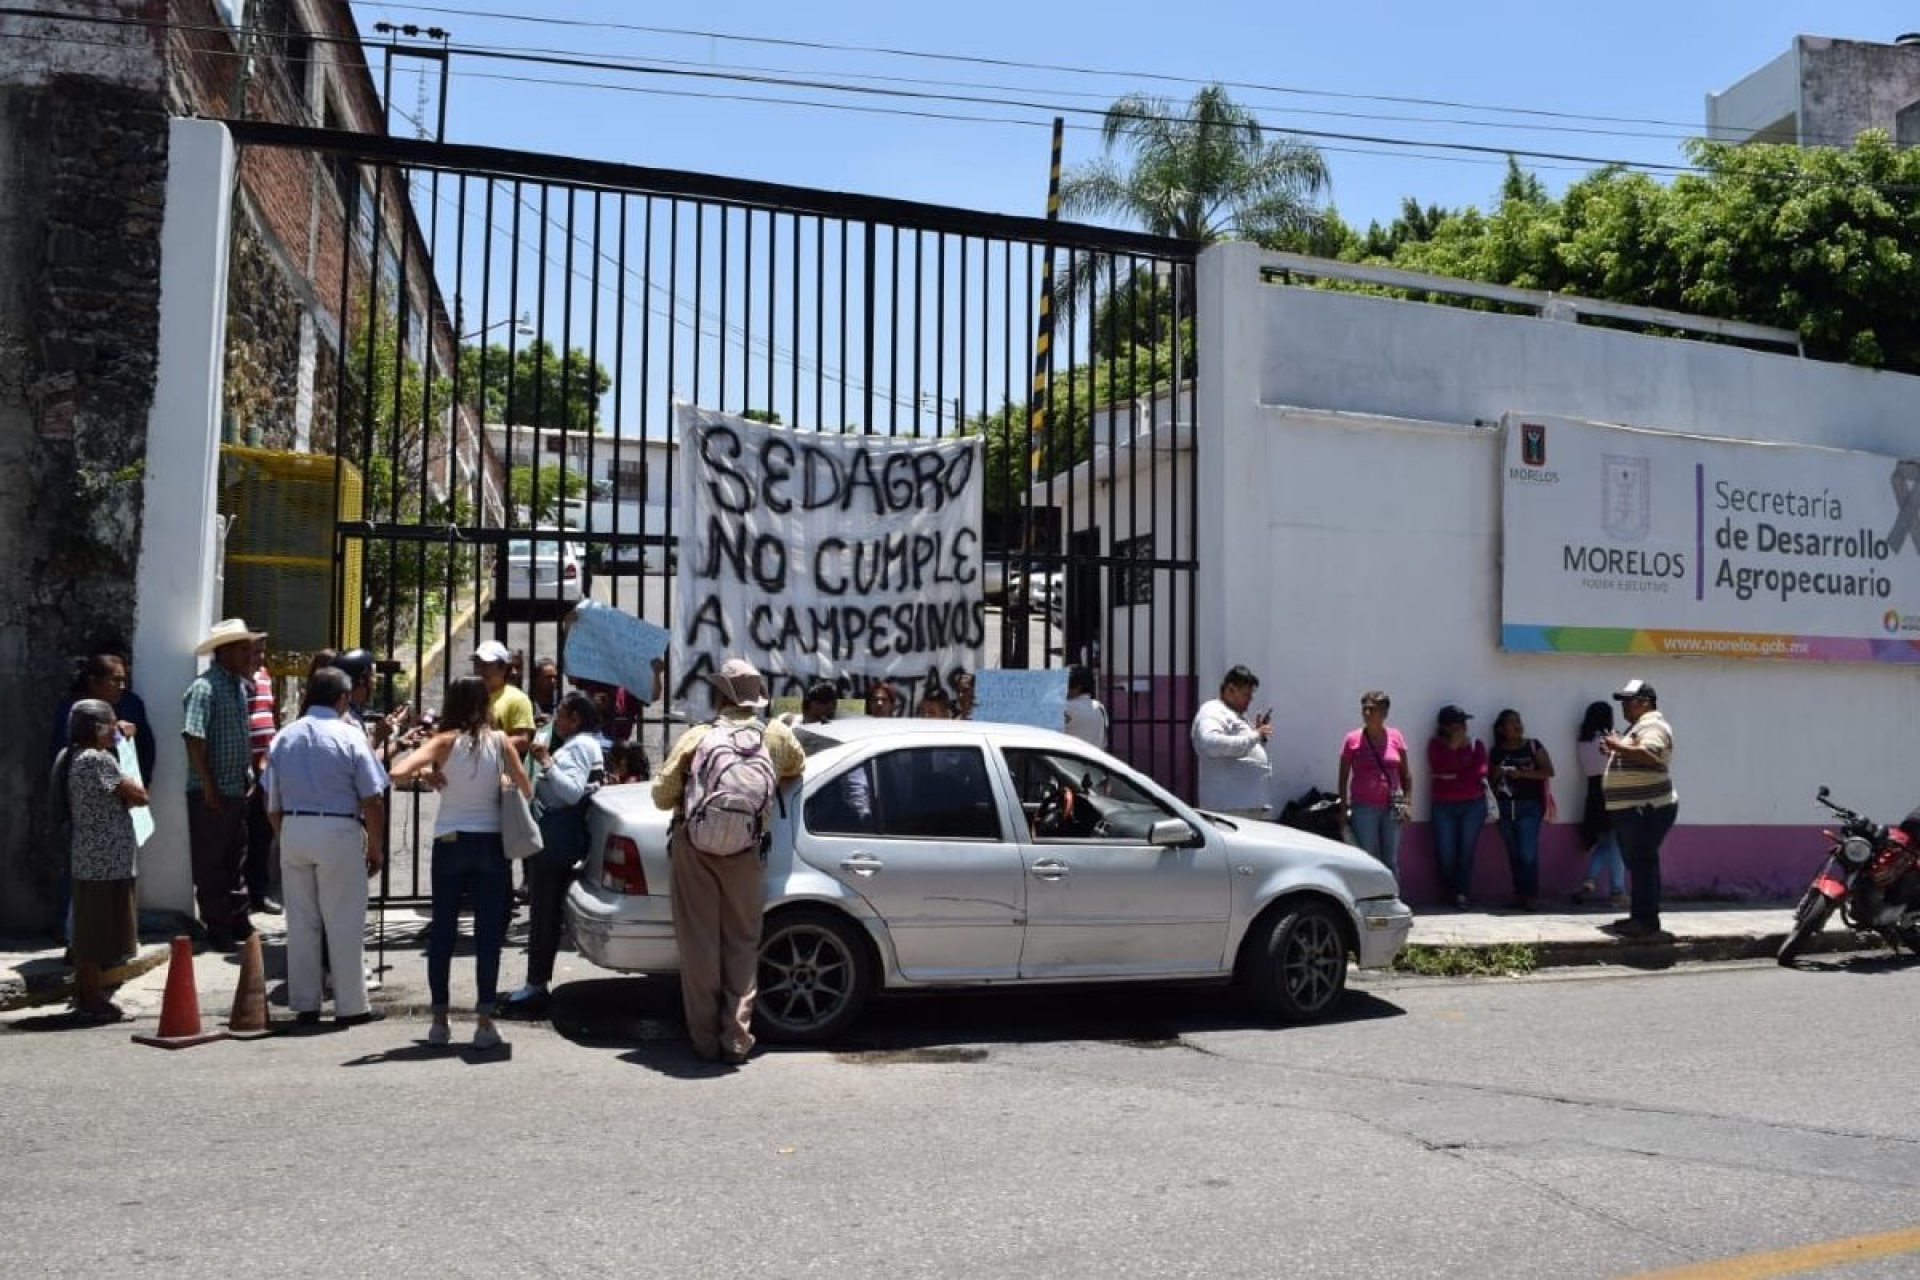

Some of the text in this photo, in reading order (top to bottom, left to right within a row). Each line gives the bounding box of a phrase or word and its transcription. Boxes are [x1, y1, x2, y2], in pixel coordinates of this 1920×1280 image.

[700, 425, 975, 515] SEDAGRO
[1714, 480, 1843, 521] Secretaría
[695, 515, 977, 596] NO CUMPLE
[1562, 544, 1686, 579] MORELOS
[1715, 521, 1889, 561] de Desarrollo
[1714, 558, 1892, 602] Agropecuario
[686, 594, 985, 660] A CAMPESINOS
